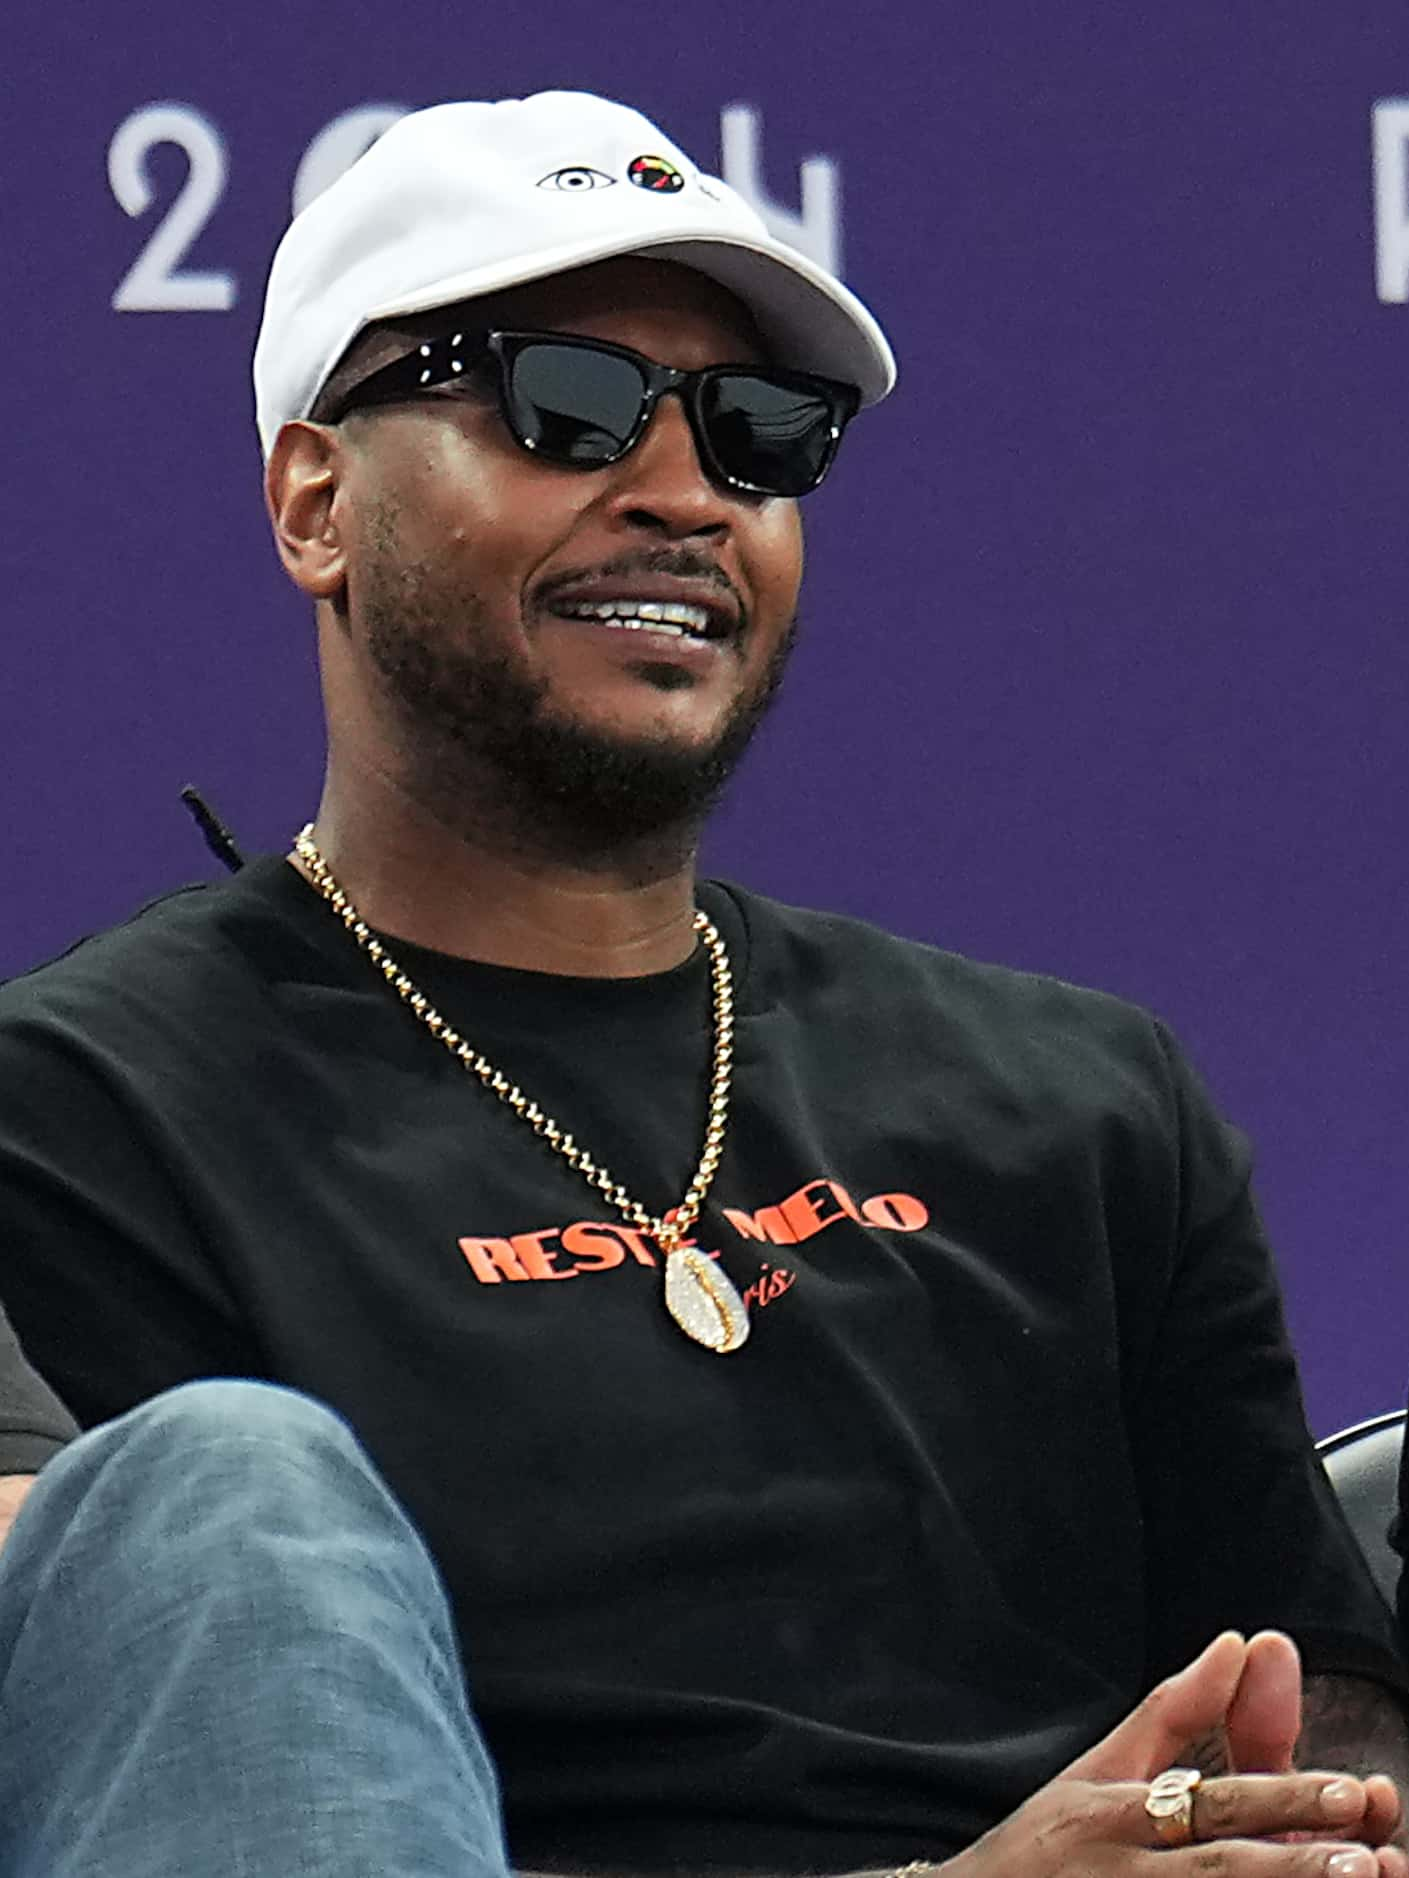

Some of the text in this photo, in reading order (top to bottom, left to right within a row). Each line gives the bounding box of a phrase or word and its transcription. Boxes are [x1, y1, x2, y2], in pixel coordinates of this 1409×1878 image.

[107, 100, 842, 312] 24
[722, 1179, 930, 1246] MELO
[743, 1263, 797, 1312] ris
